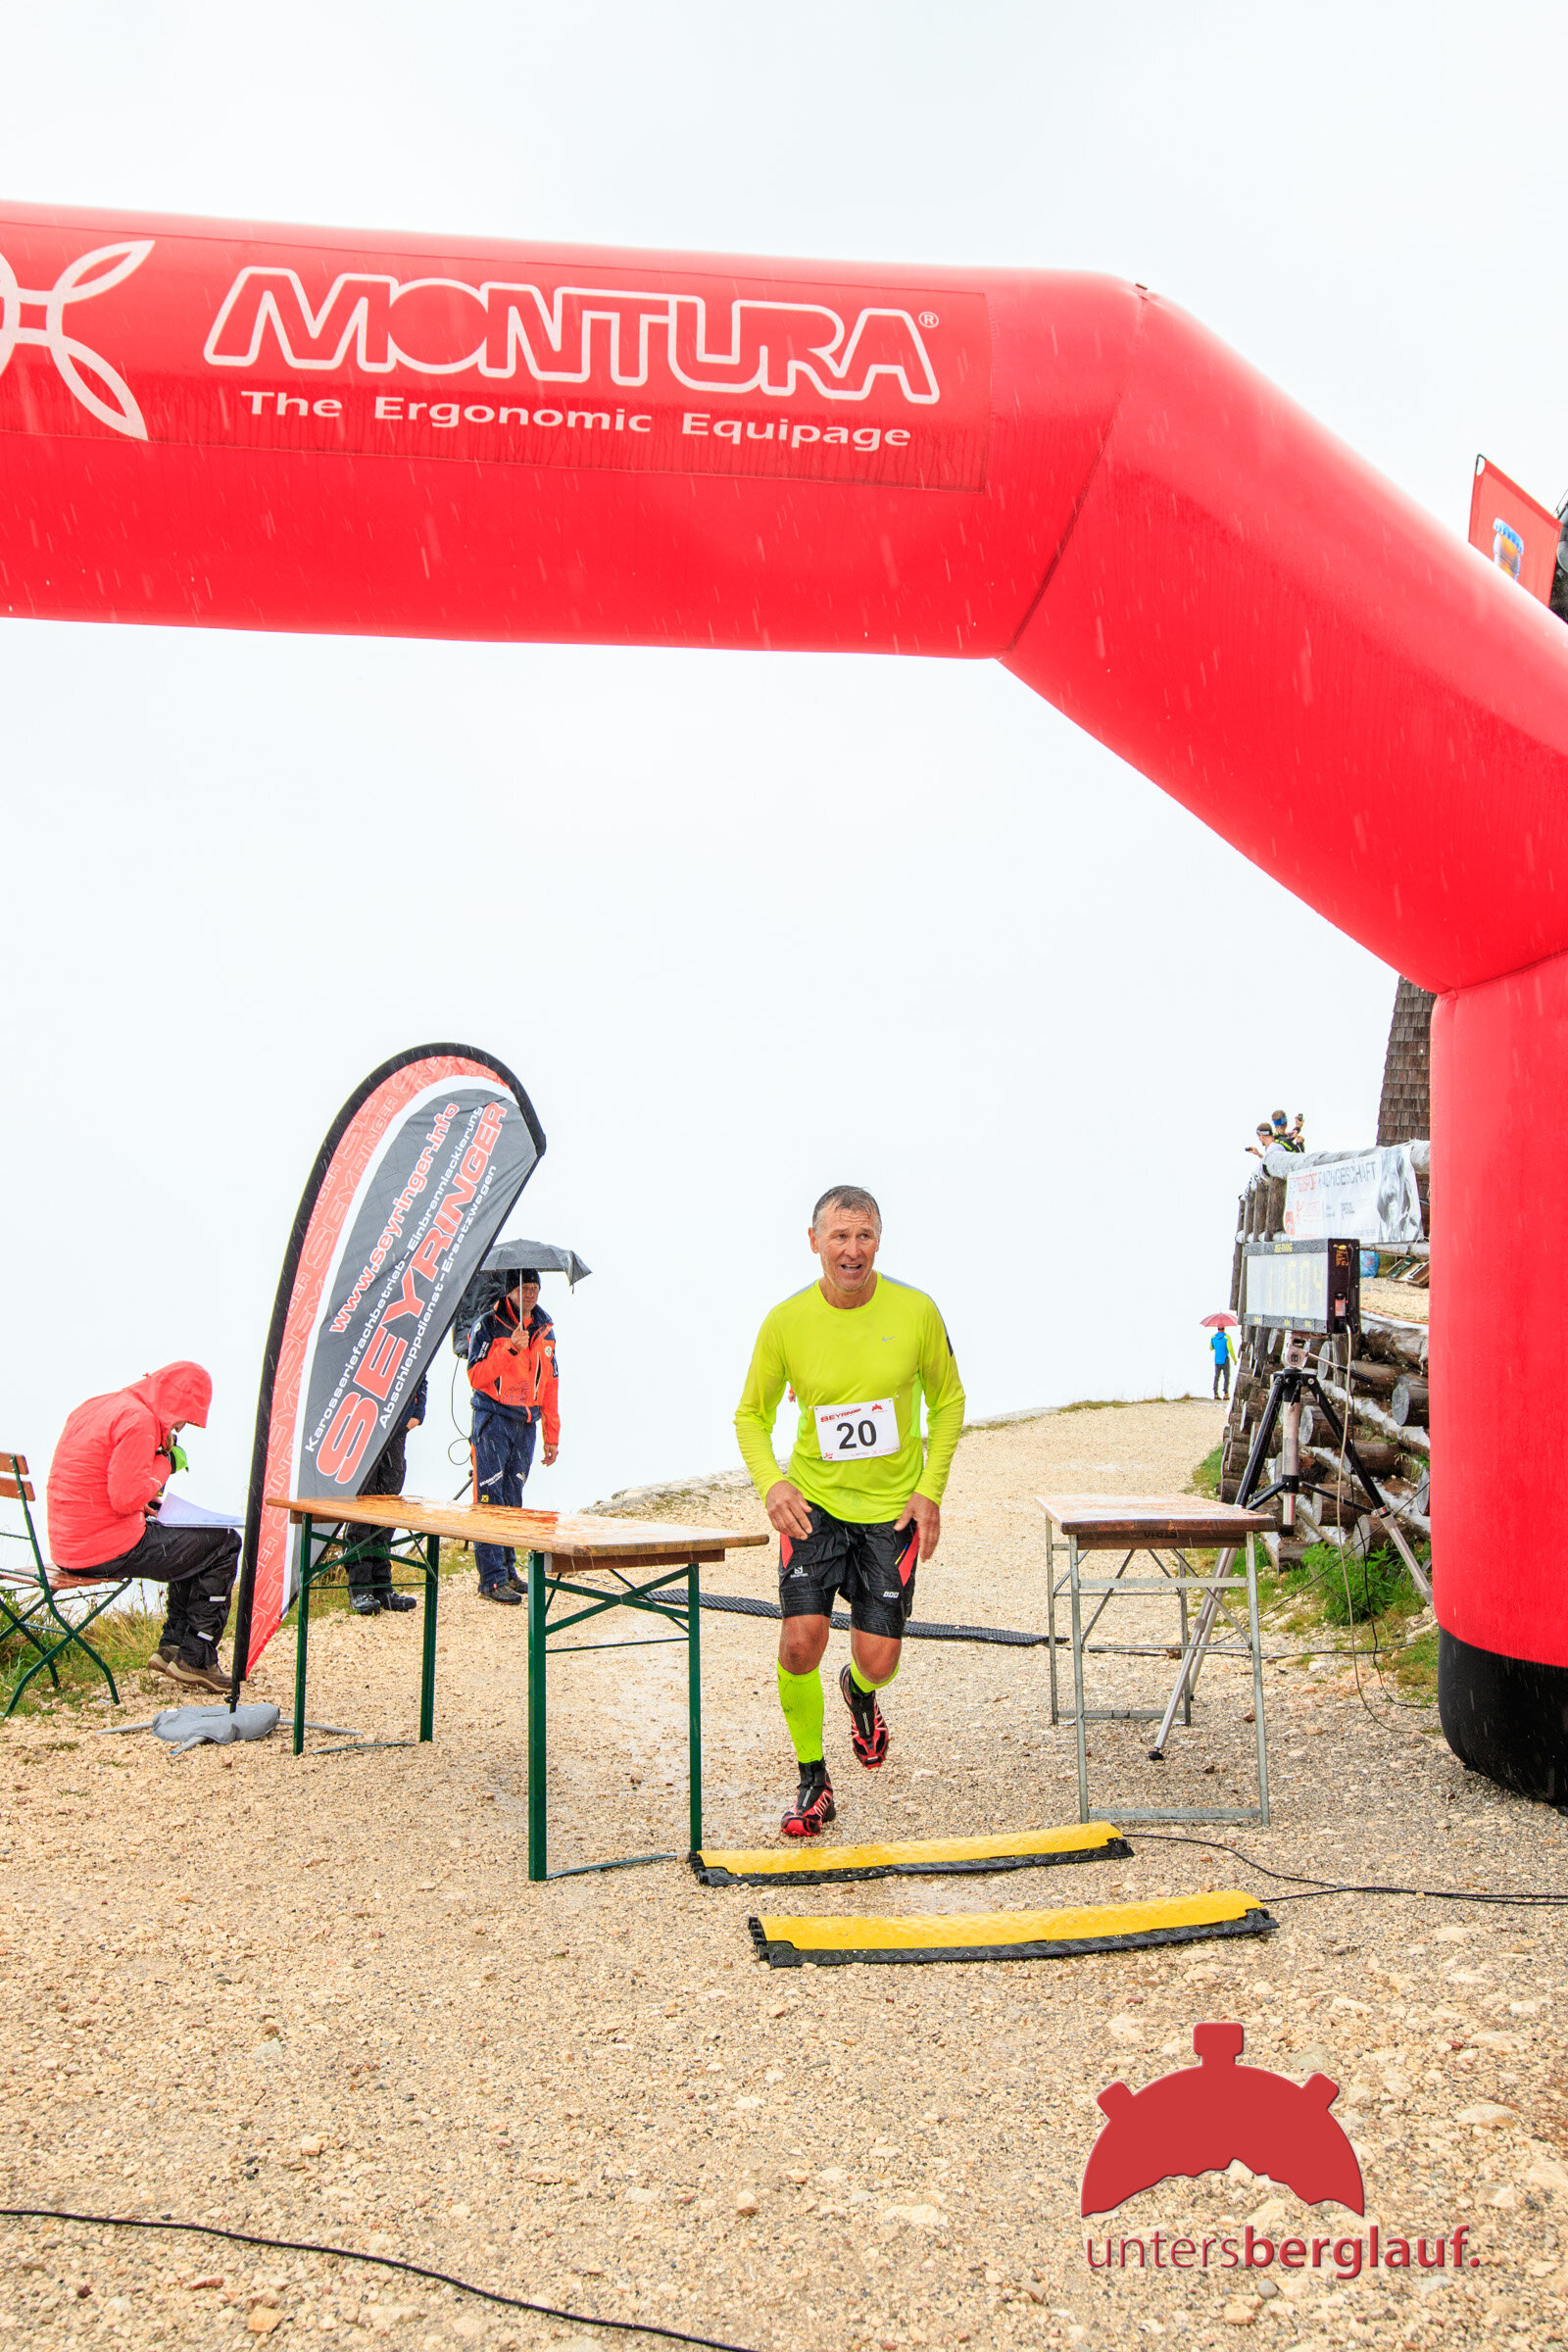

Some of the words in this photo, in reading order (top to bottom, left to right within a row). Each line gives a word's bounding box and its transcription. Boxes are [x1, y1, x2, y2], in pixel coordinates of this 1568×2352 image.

[241, 391, 343, 418] The
[374, 395, 653, 435] Ergonomic
[682, 412, 911, 452] Equipage
[329, 1102, 460, 1334] www.seyringer.info
[316, 1102, 508, 1485] SEYRINGER
[836, 1419, 877, 1450] 20
